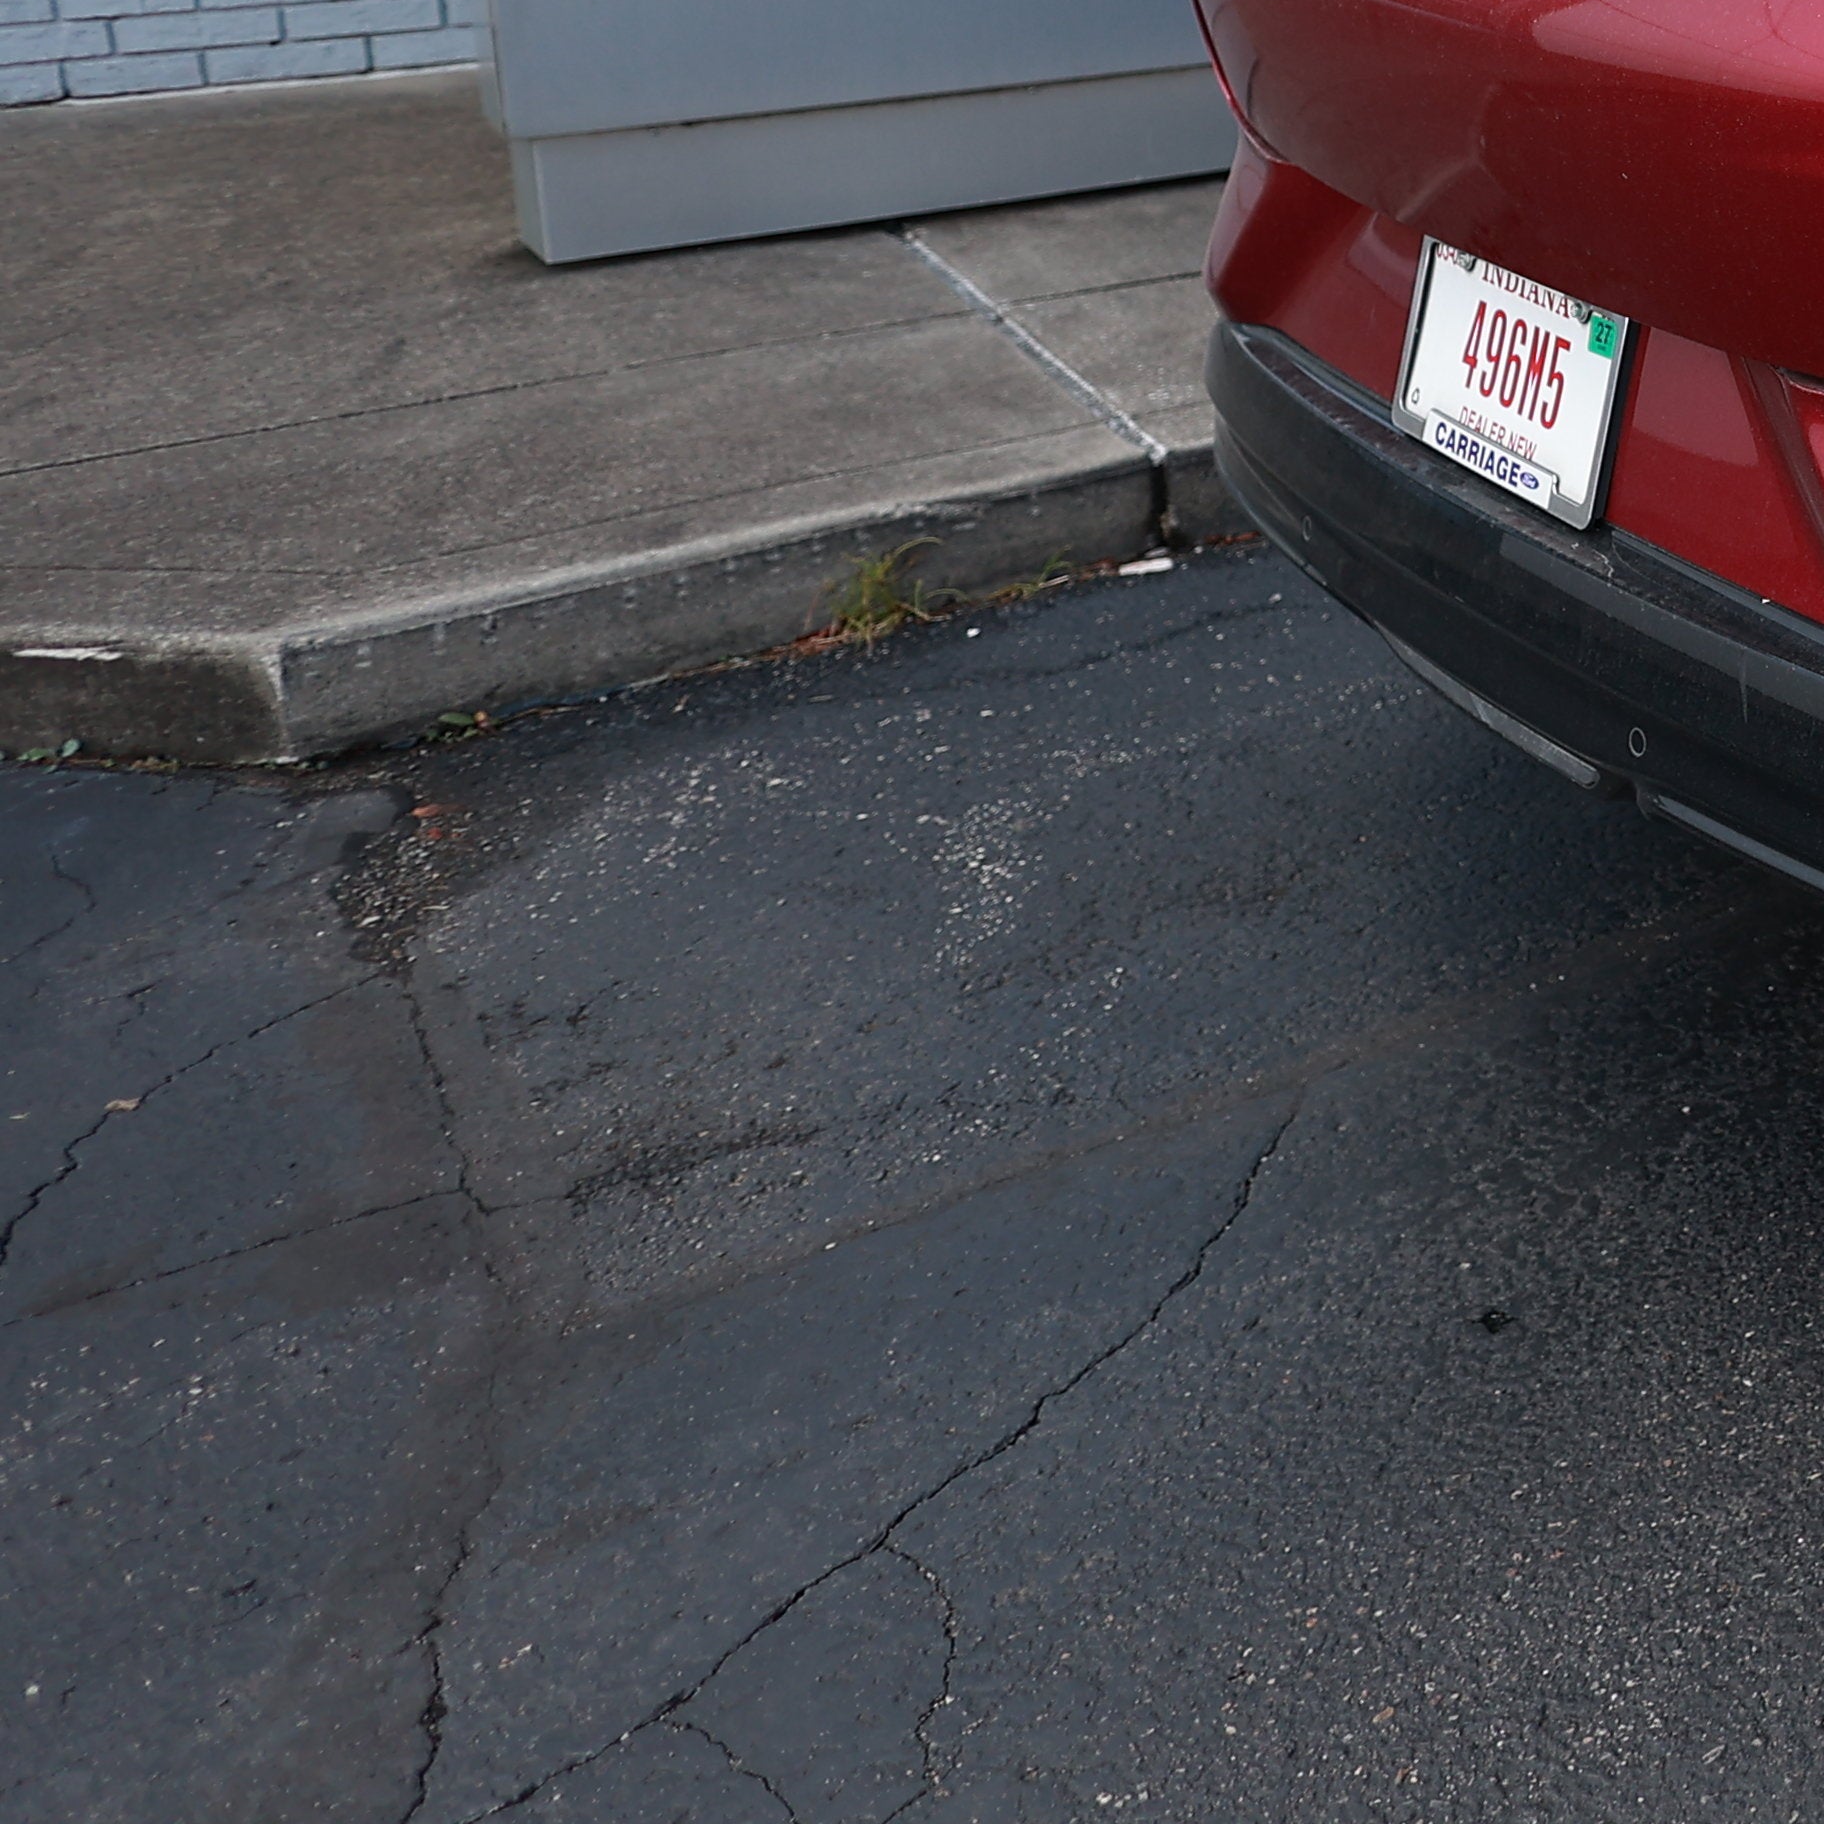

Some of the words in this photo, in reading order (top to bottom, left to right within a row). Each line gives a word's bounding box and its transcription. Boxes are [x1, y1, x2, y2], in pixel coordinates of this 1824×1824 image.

[1481, 262, 1571, 319] INDIANA
[1595, 321, 1613, 345] 27
[1462, 300, 1571, 430] 496M5
[1435, 422, 1521, 487] CARRIAGE
[1459, 406, 1506, 446] DEALER
[1508, 430, 1537, 461] NEW
